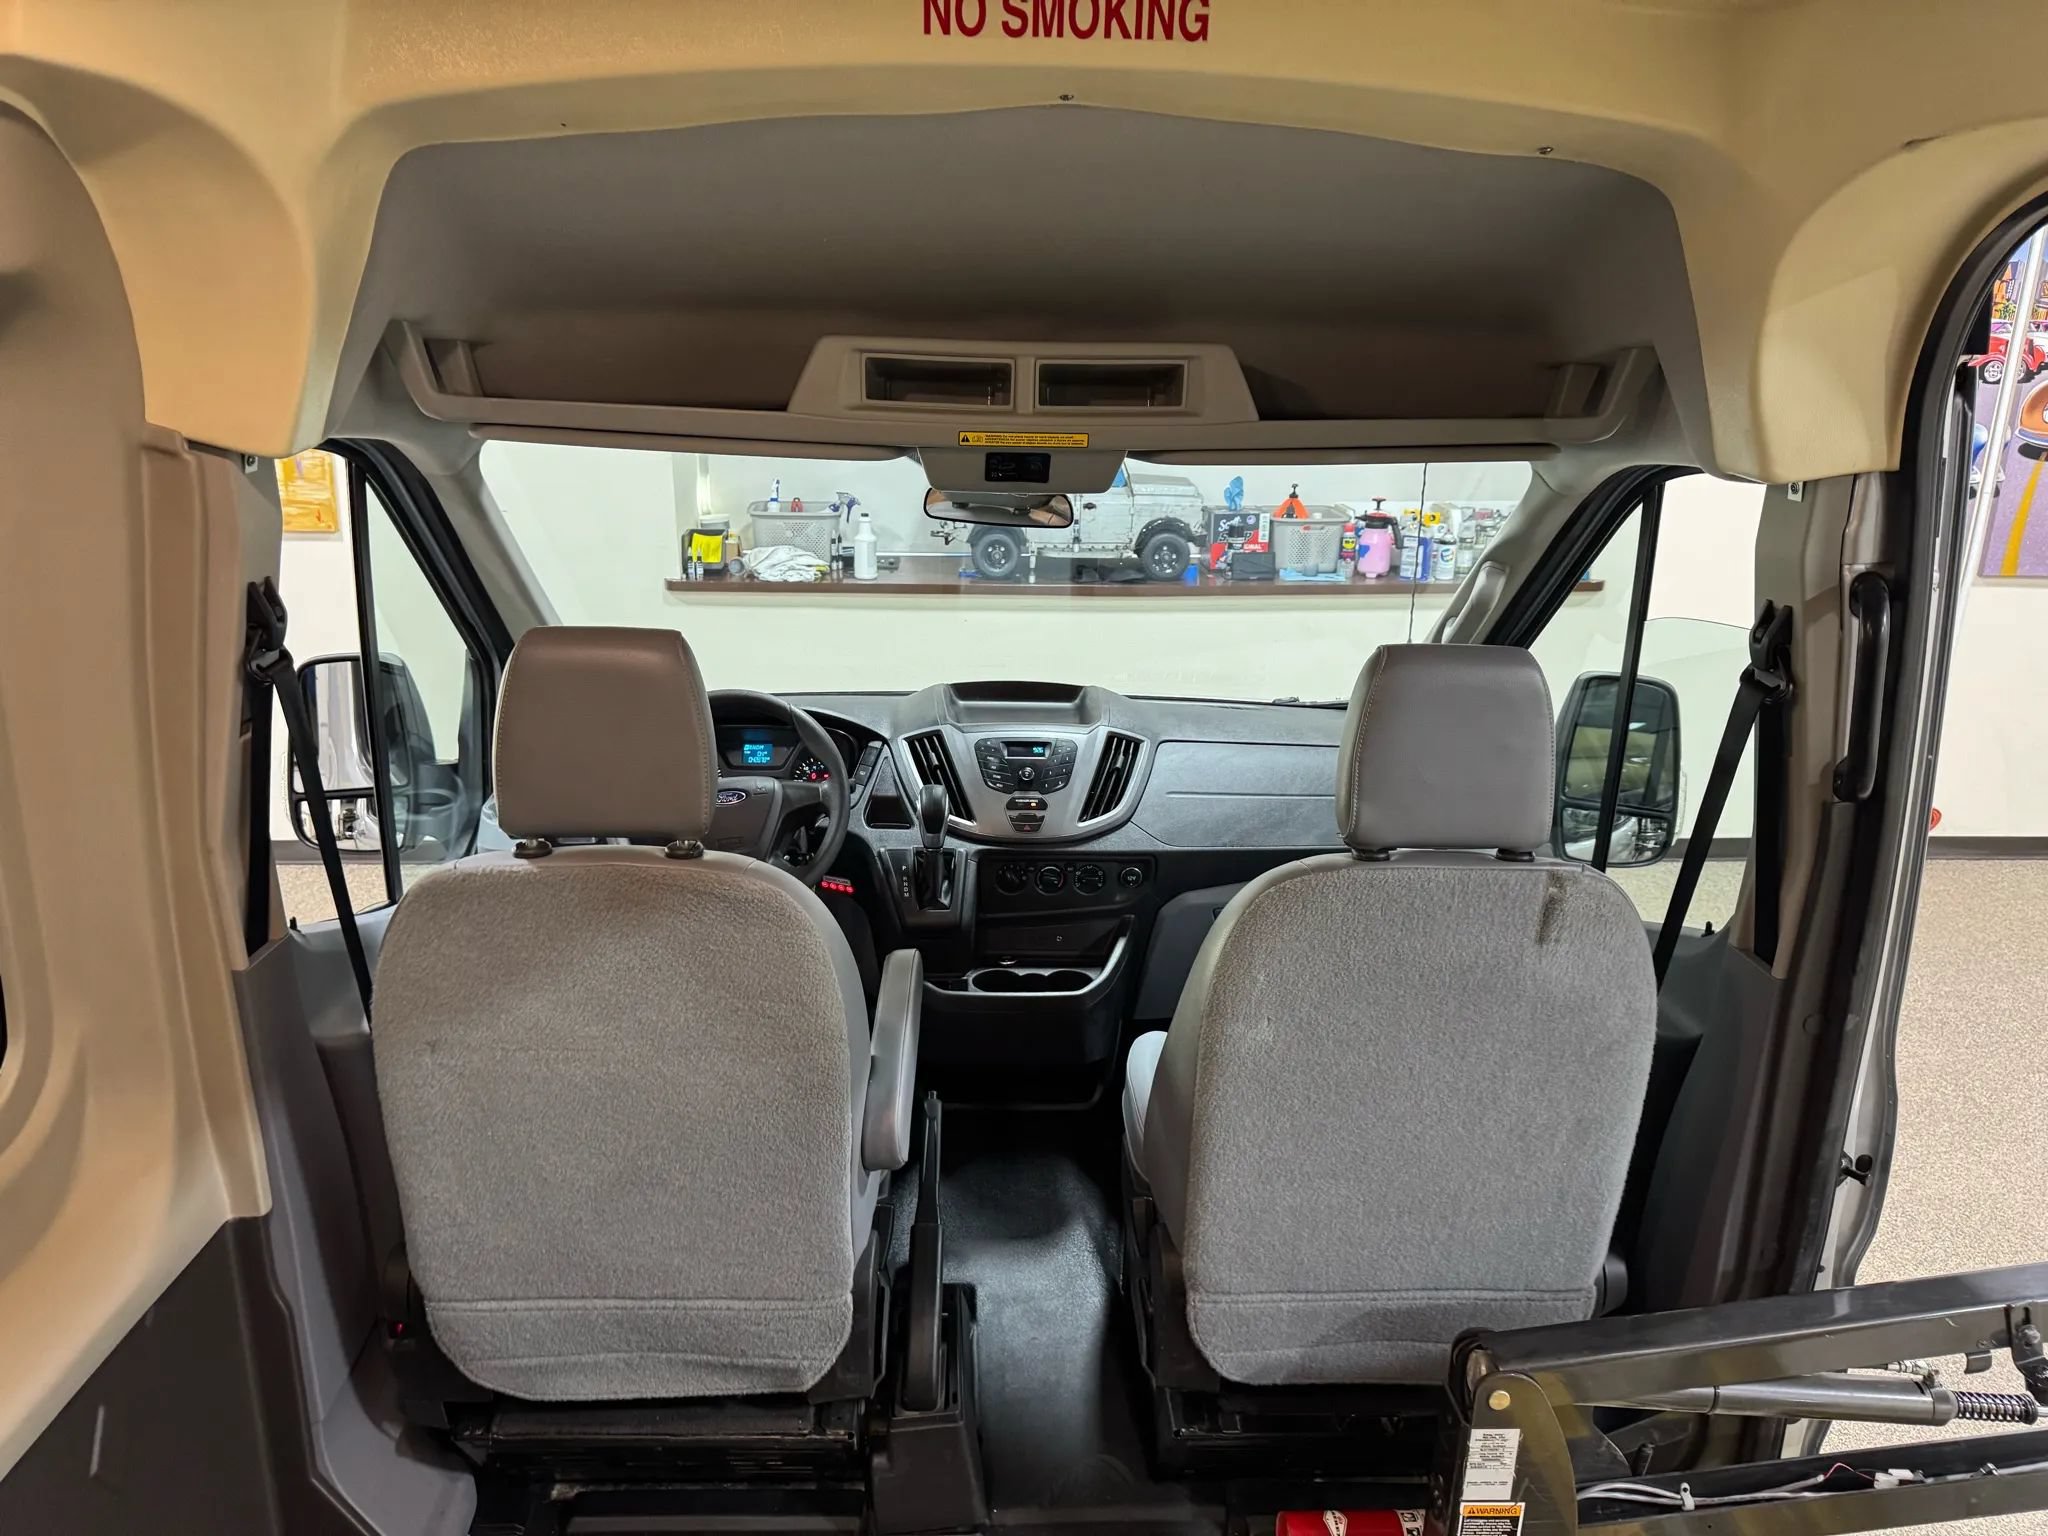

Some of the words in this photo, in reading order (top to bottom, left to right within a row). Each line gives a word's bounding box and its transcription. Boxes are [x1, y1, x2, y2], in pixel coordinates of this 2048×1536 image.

[923, 0, 987, 37] NO
[1001, 0, 1210, 42] SMOKING
[717, 793, 738, 803] Ford
[1476, 1507, 1517, 1515] WARNING
